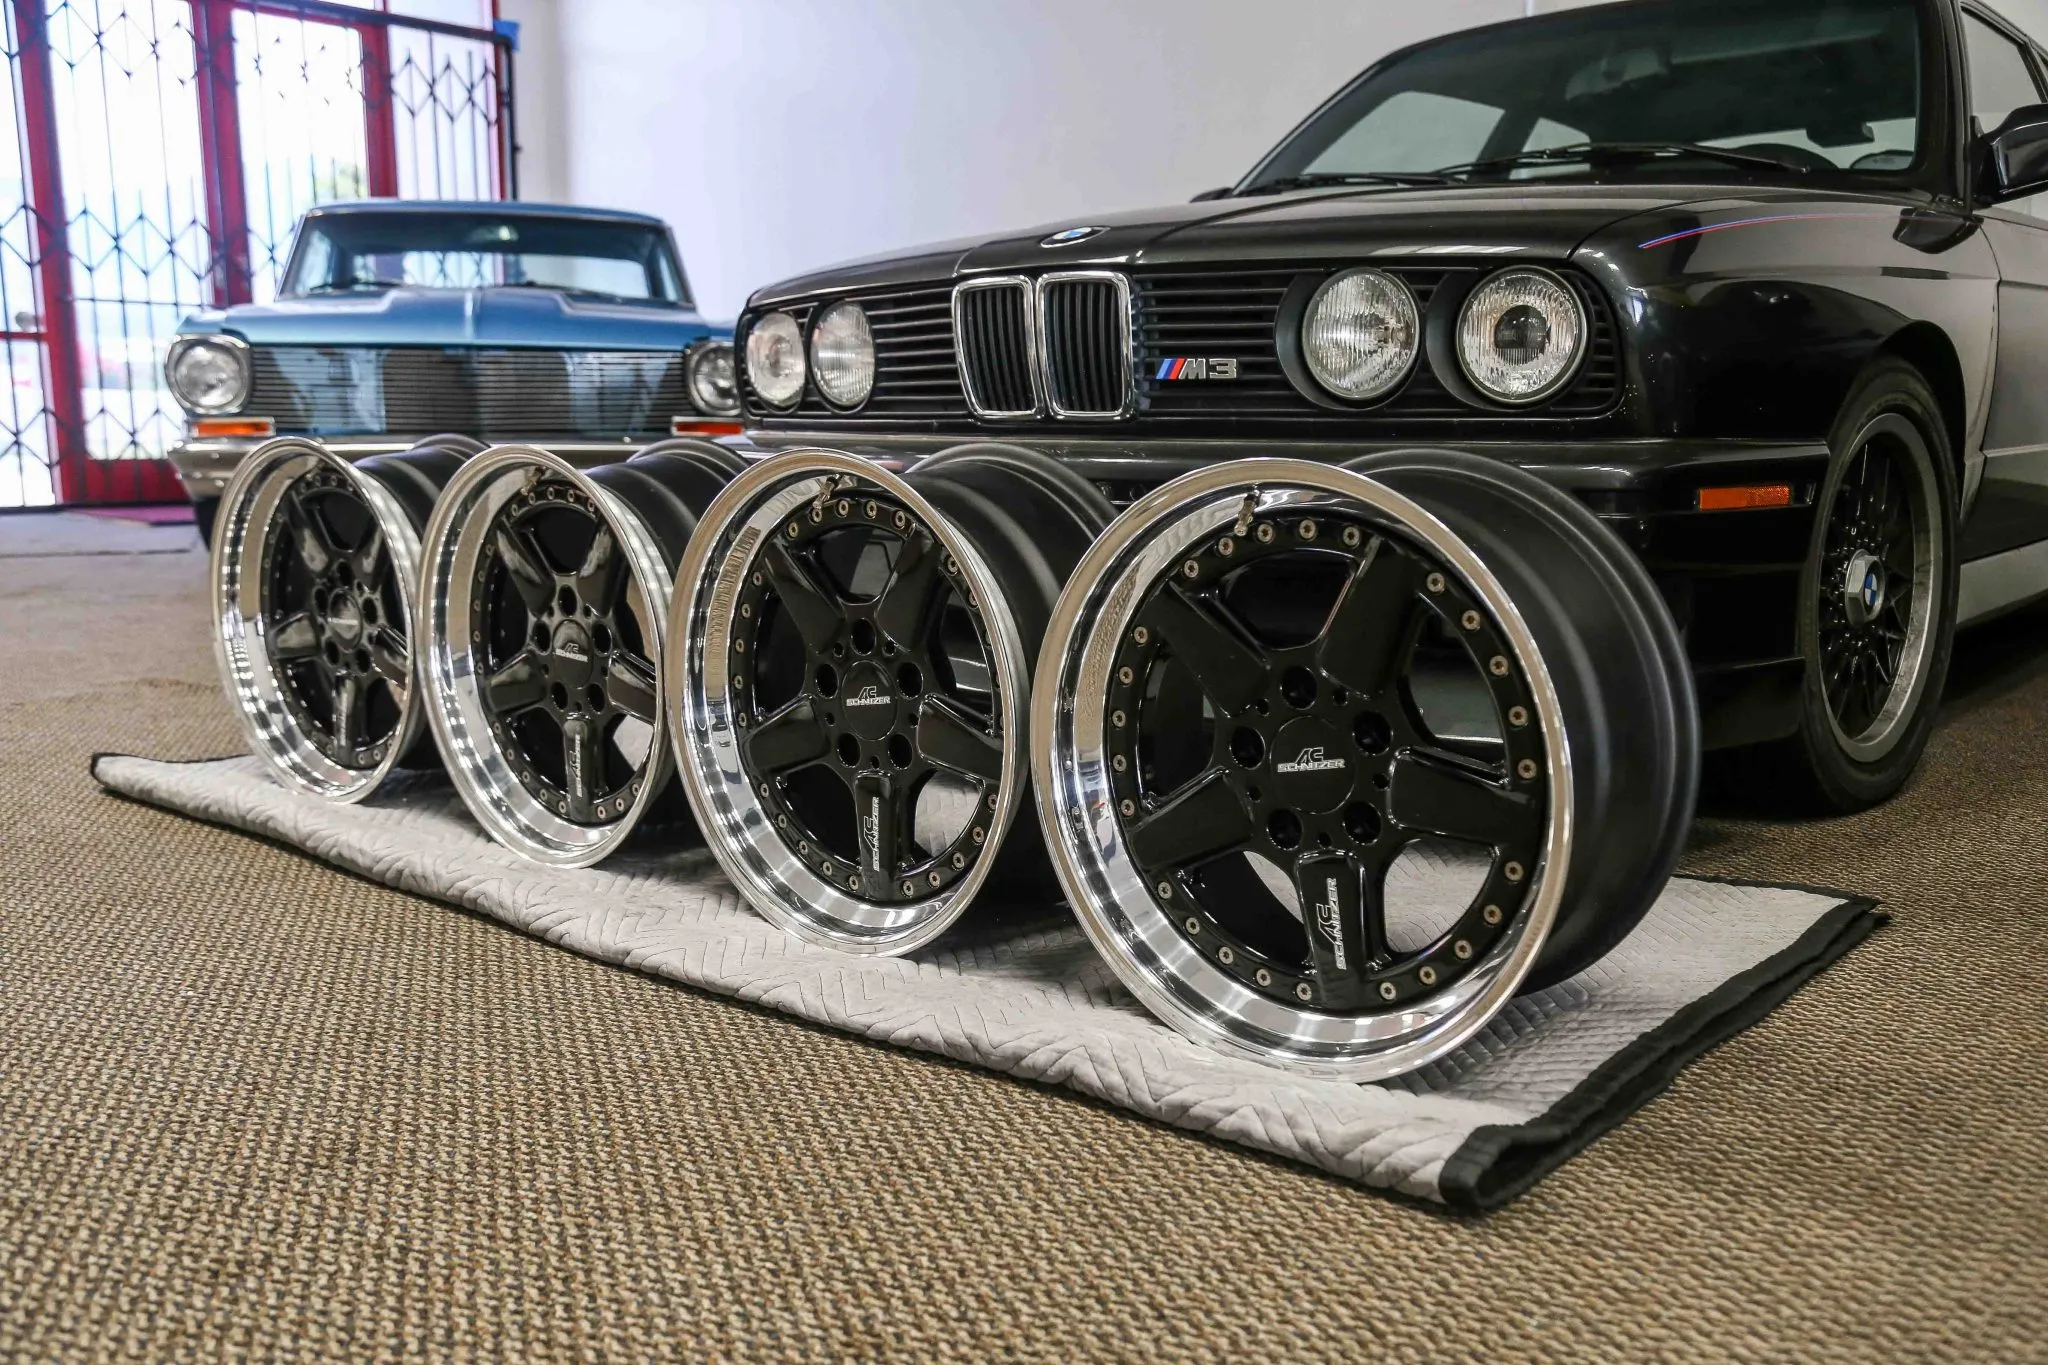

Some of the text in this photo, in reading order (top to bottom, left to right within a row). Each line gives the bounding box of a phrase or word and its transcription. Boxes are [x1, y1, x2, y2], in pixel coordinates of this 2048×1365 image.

[1178, 358, 1237, 379] M3
[858, 686, 877, 699] AC
[1278, 758, 1345, 773] SCHNITZER
[1295, 747, 1324, 764] AC
[863, 815, 874, 850] AC
[1316, 903, 1336, 945] AC
[1326, 877, 1347, 971] SCHNITZER
